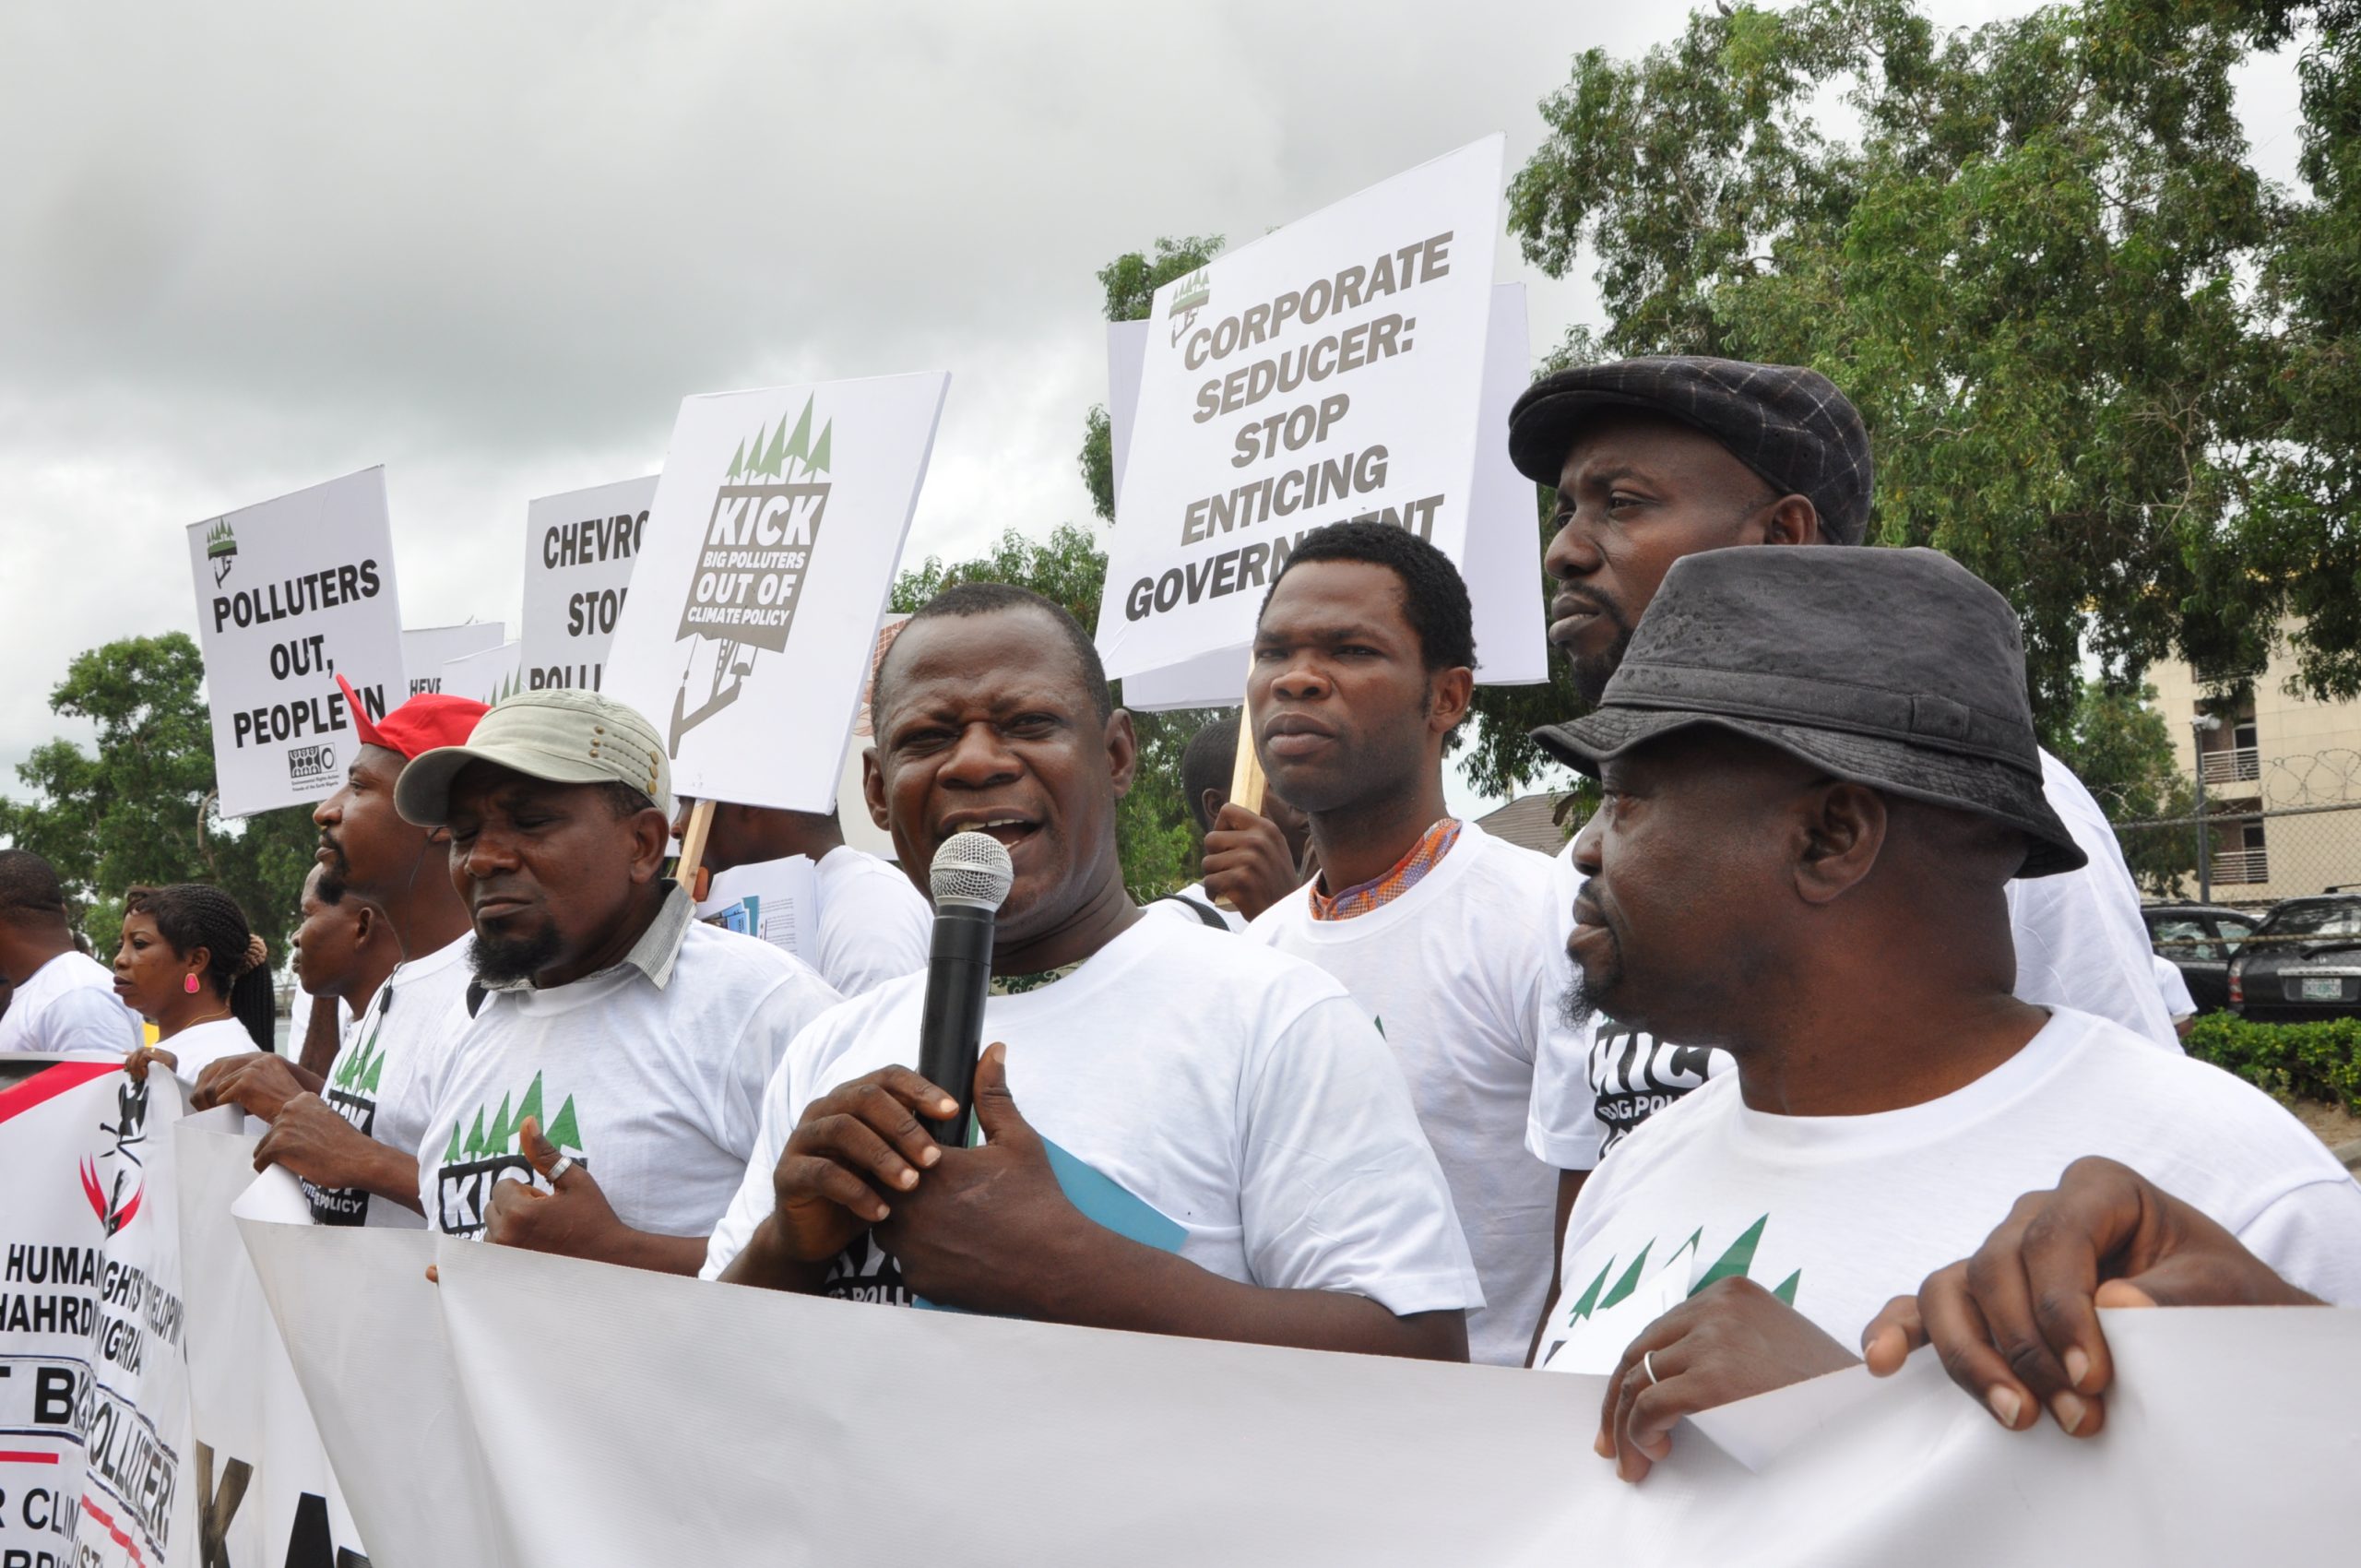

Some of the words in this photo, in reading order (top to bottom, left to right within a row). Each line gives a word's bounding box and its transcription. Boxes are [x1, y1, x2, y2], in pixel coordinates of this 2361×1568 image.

[1184, 231, 1453, 370] CORPORATE
[1192, 314, 1417, 423] SEDUCER:
[1231, 393, 1350, 468] STOP
[708, 495, 824, 546] KICK
[1181, 445, 1389, 546] ENTICING
[703, 551, 727, 567] BIG
[728, 552, 806, 569] POLLUTERS
[213, 559, 380, 633] POLLUTERS
[567, 588, 628, 636] STO
[696, 572, 754, 604] OUT
[757, 574, 797, 605] OF
[687, 607, 742, 624] CLIMATE
[742, 609, 790, 626] POLICY
[270, 635, 334, 679] OUT,
[233, 693, 347, 748] PEOPLE
[1592, 1032, 1706, 1097] KIC
